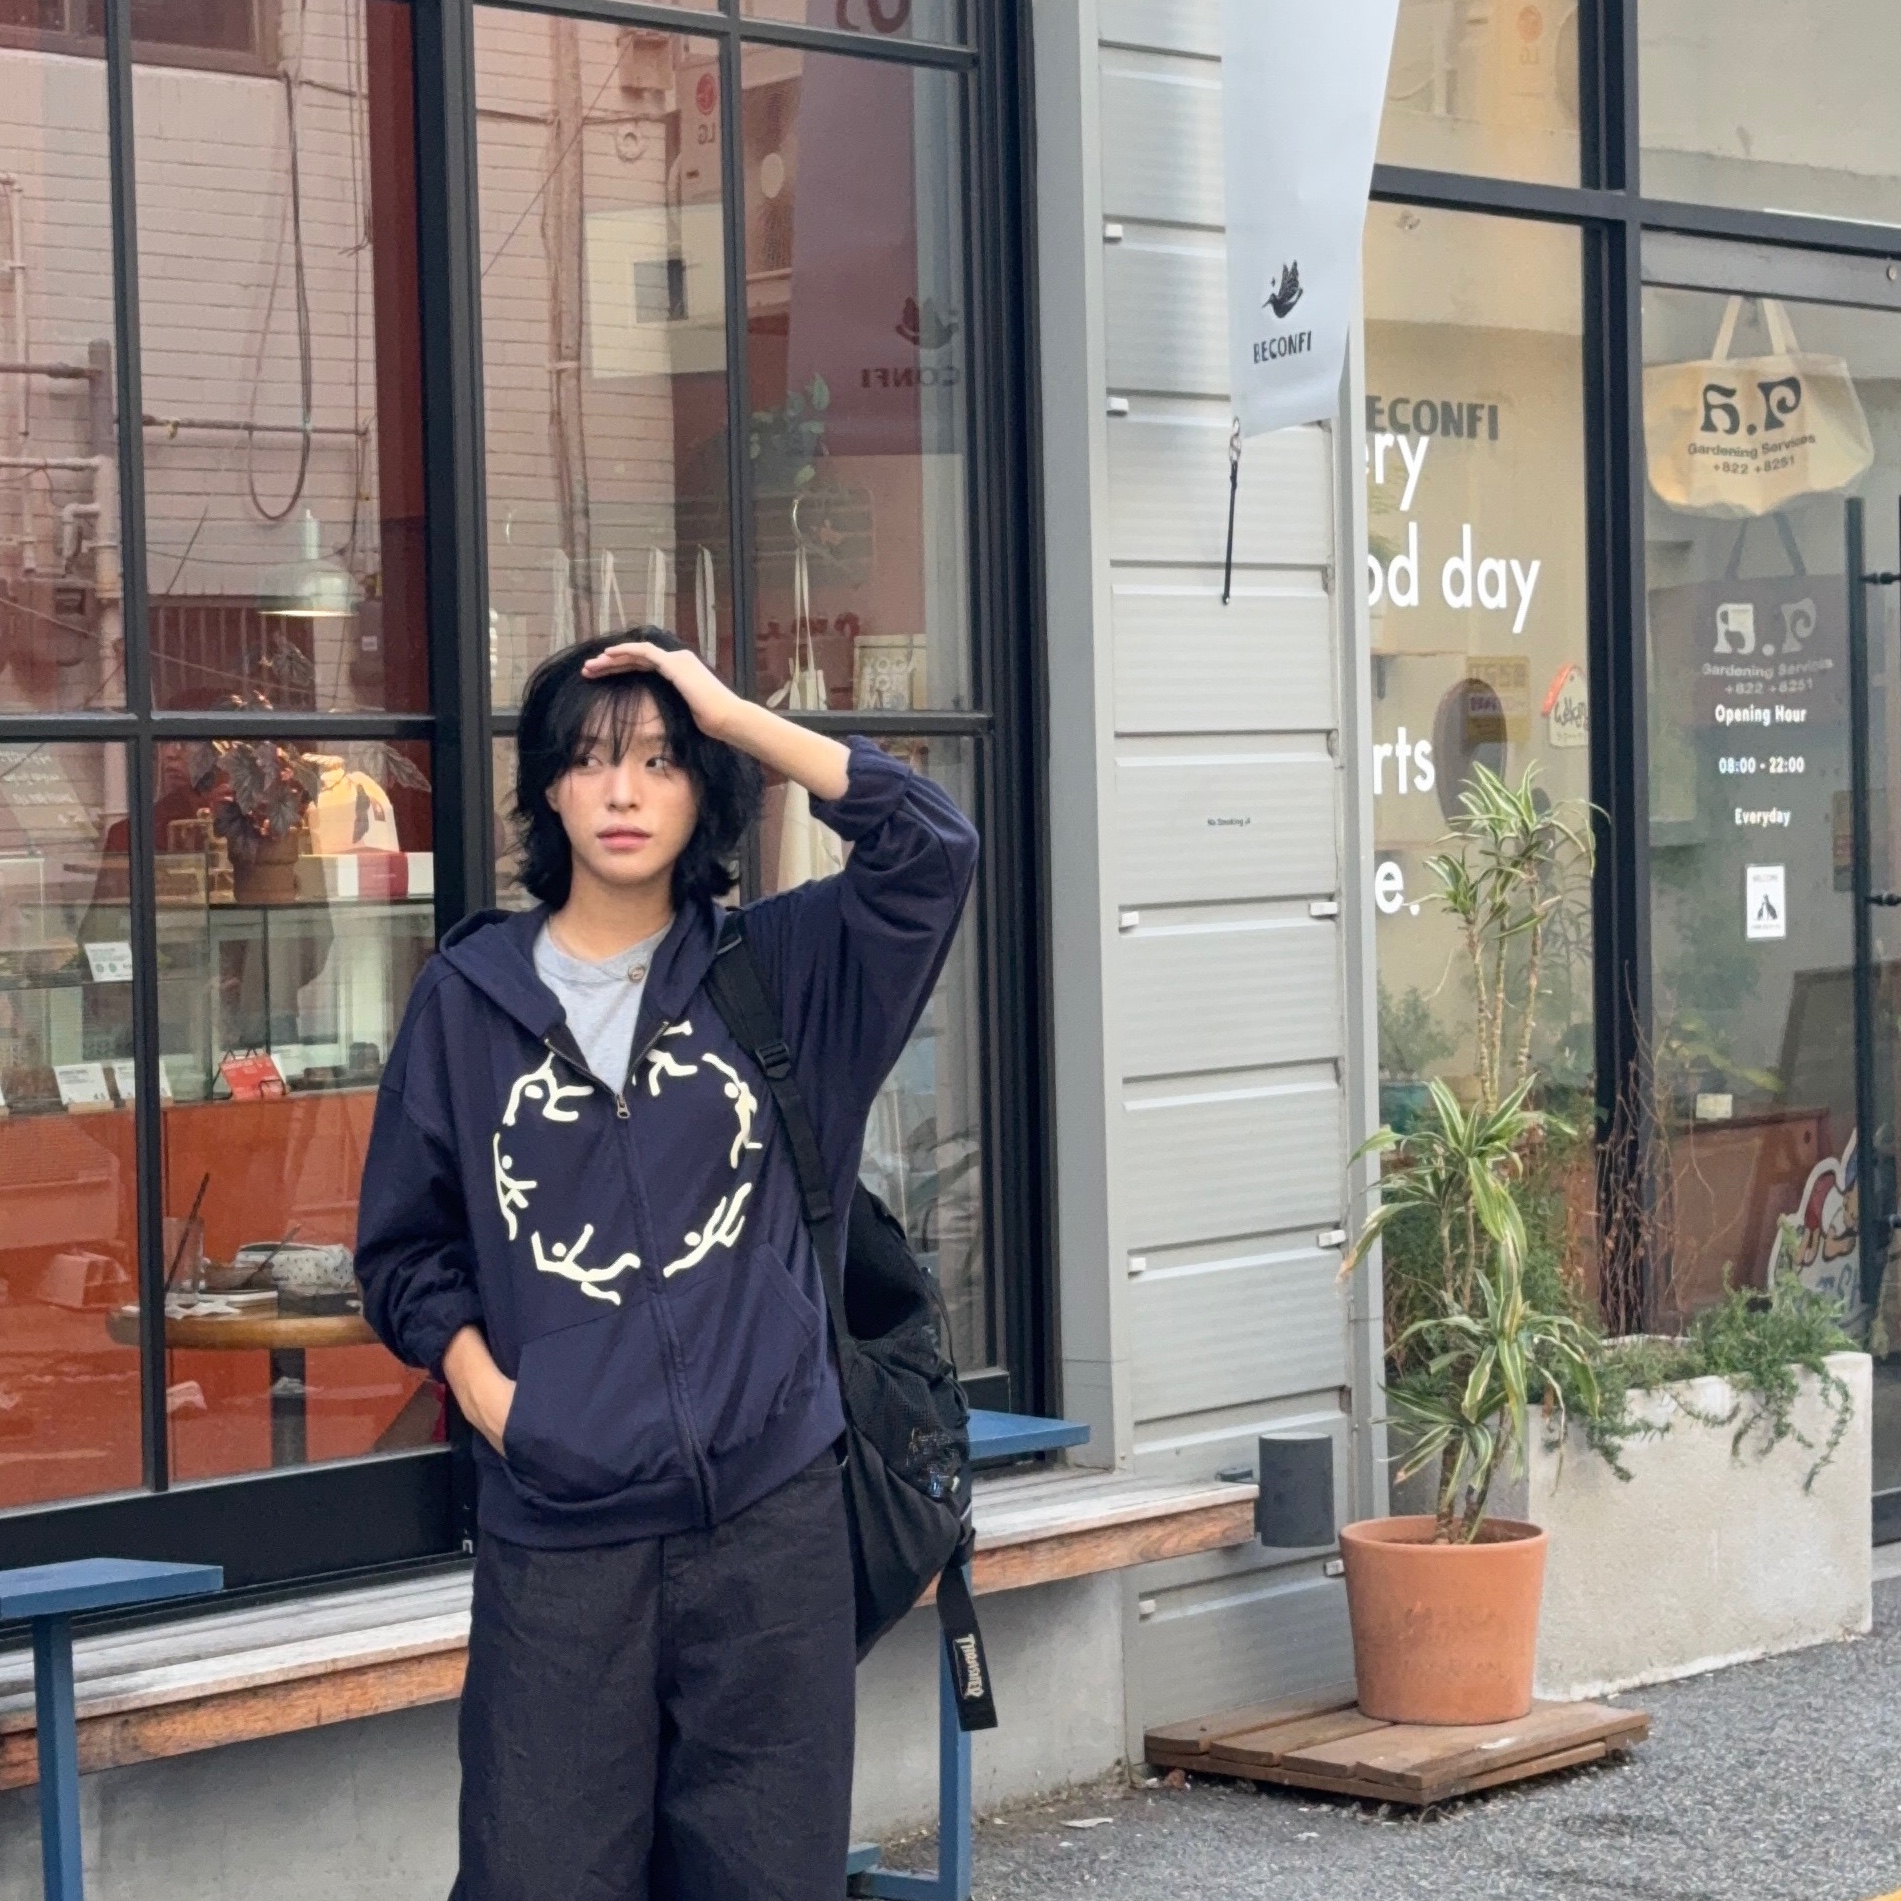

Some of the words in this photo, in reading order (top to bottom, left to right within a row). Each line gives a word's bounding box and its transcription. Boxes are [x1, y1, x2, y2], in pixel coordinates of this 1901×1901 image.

[1253, 330, 1312, 364] BECONFI
[1442, 523, 1541, 634] day
[1715, 704, 1771, 727] Opening
[1775, 705, 1807, 722] Hour
[1719, 757, 1756, 774] 08:00
[1769, 756, 1805, 773] 22:00
[1735, 807, 1791, 828] Everyday
